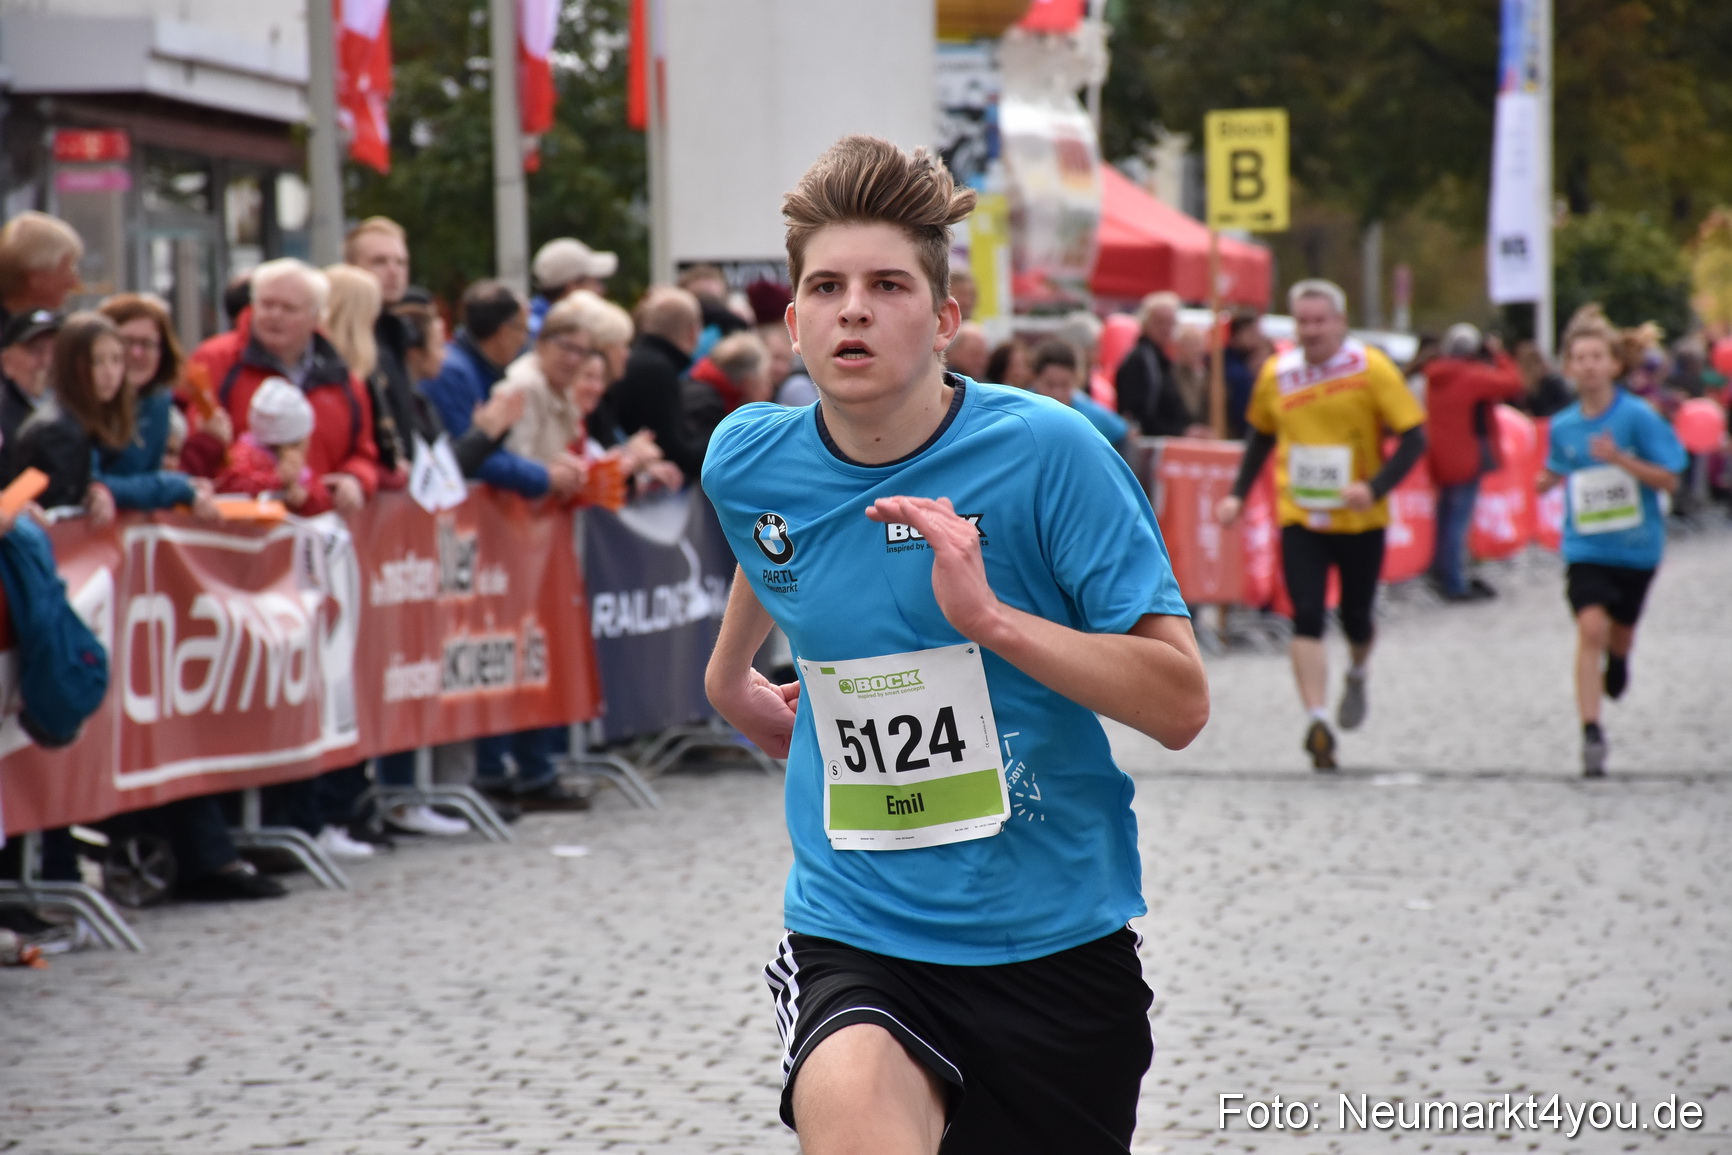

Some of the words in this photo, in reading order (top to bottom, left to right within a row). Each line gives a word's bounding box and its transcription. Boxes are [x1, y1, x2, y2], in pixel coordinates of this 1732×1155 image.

[1228, 148, 1266, 203] B
[757, 515, 786, 533] BMW
[886, 543, 914, 553] inspired
[916, 542, 925, 551] by
[762, 569, 798, 584] PARTL
[854, 668, 923, 693] BOCK
[835, 706, 966, 773] 5124
[1009, 761, 1026, 785] 2017
[886, 792, 925, 815] Emil
